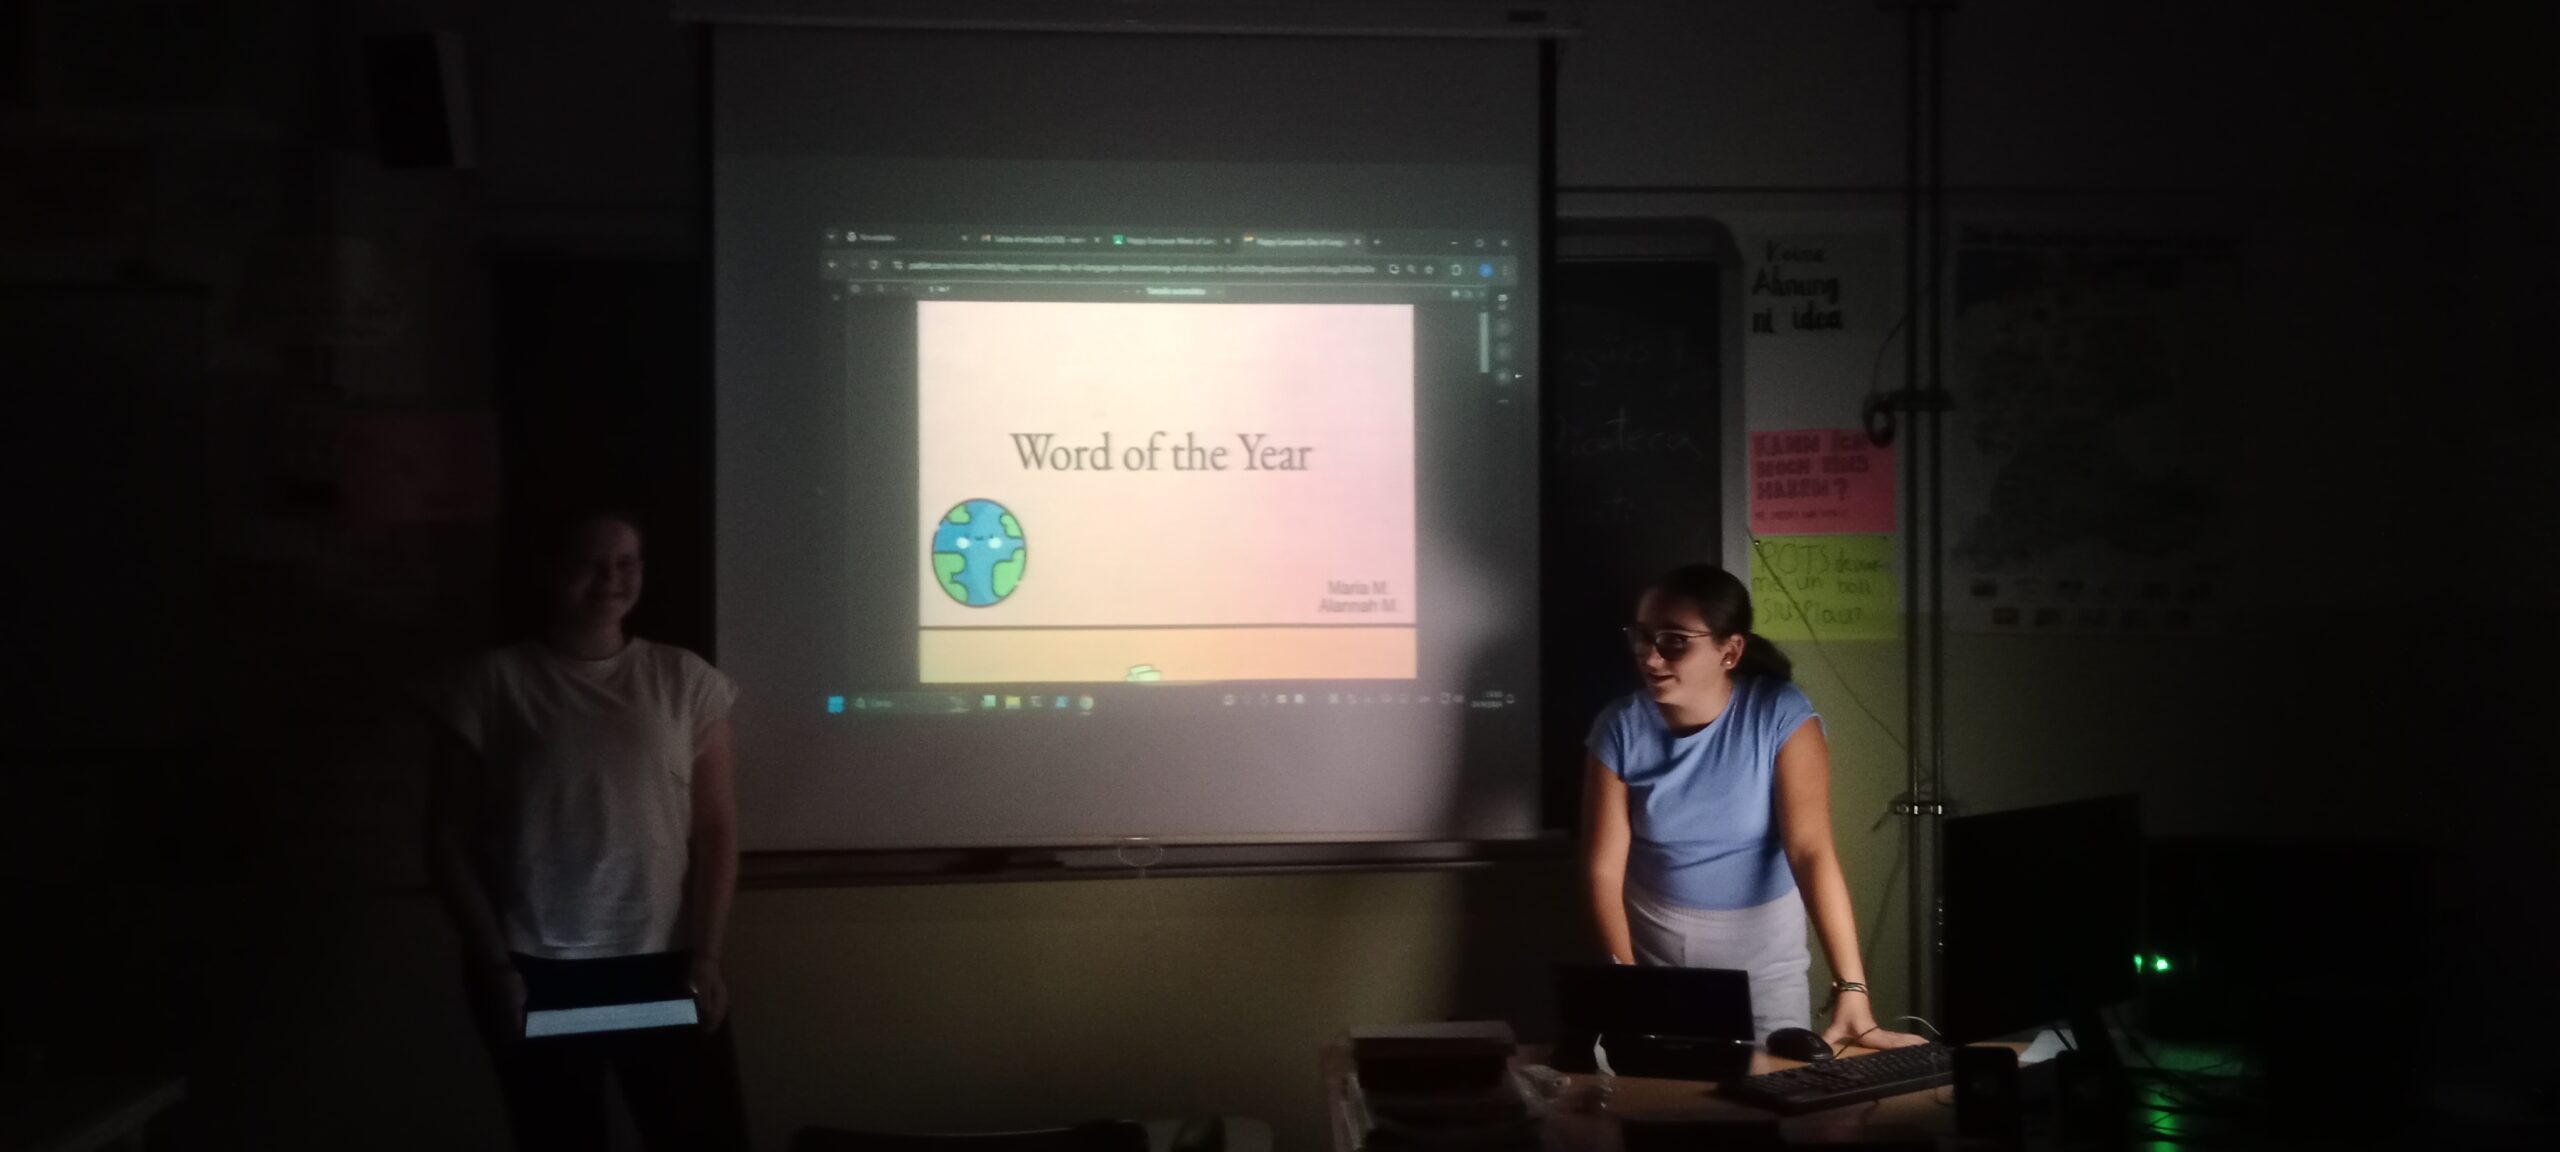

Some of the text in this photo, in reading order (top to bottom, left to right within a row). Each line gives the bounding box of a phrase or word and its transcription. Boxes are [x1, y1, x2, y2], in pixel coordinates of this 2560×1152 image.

[1752, 265, 1839, 304] Ahnung
[1792, 300, 1843, 332] idea
[1010, 430, 1314, 471] Word of the Year
